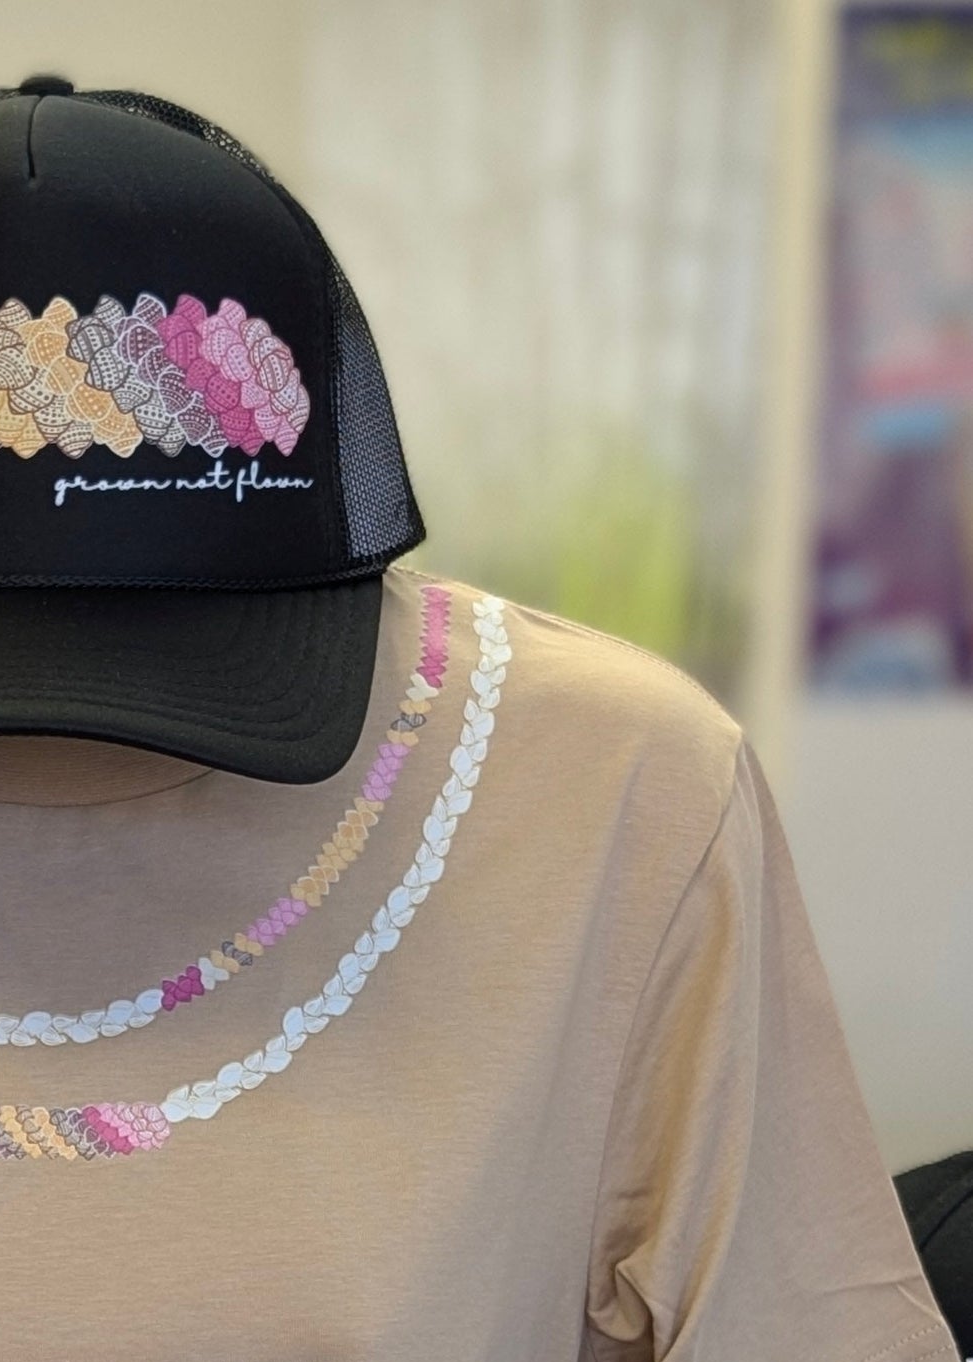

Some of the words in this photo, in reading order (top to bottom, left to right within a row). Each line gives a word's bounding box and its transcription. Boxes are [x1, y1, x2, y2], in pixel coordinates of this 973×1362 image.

[54, 476, 172, 506] grown
[175, 460, 234, 490] not
[235, 460, 314, 502] flown
